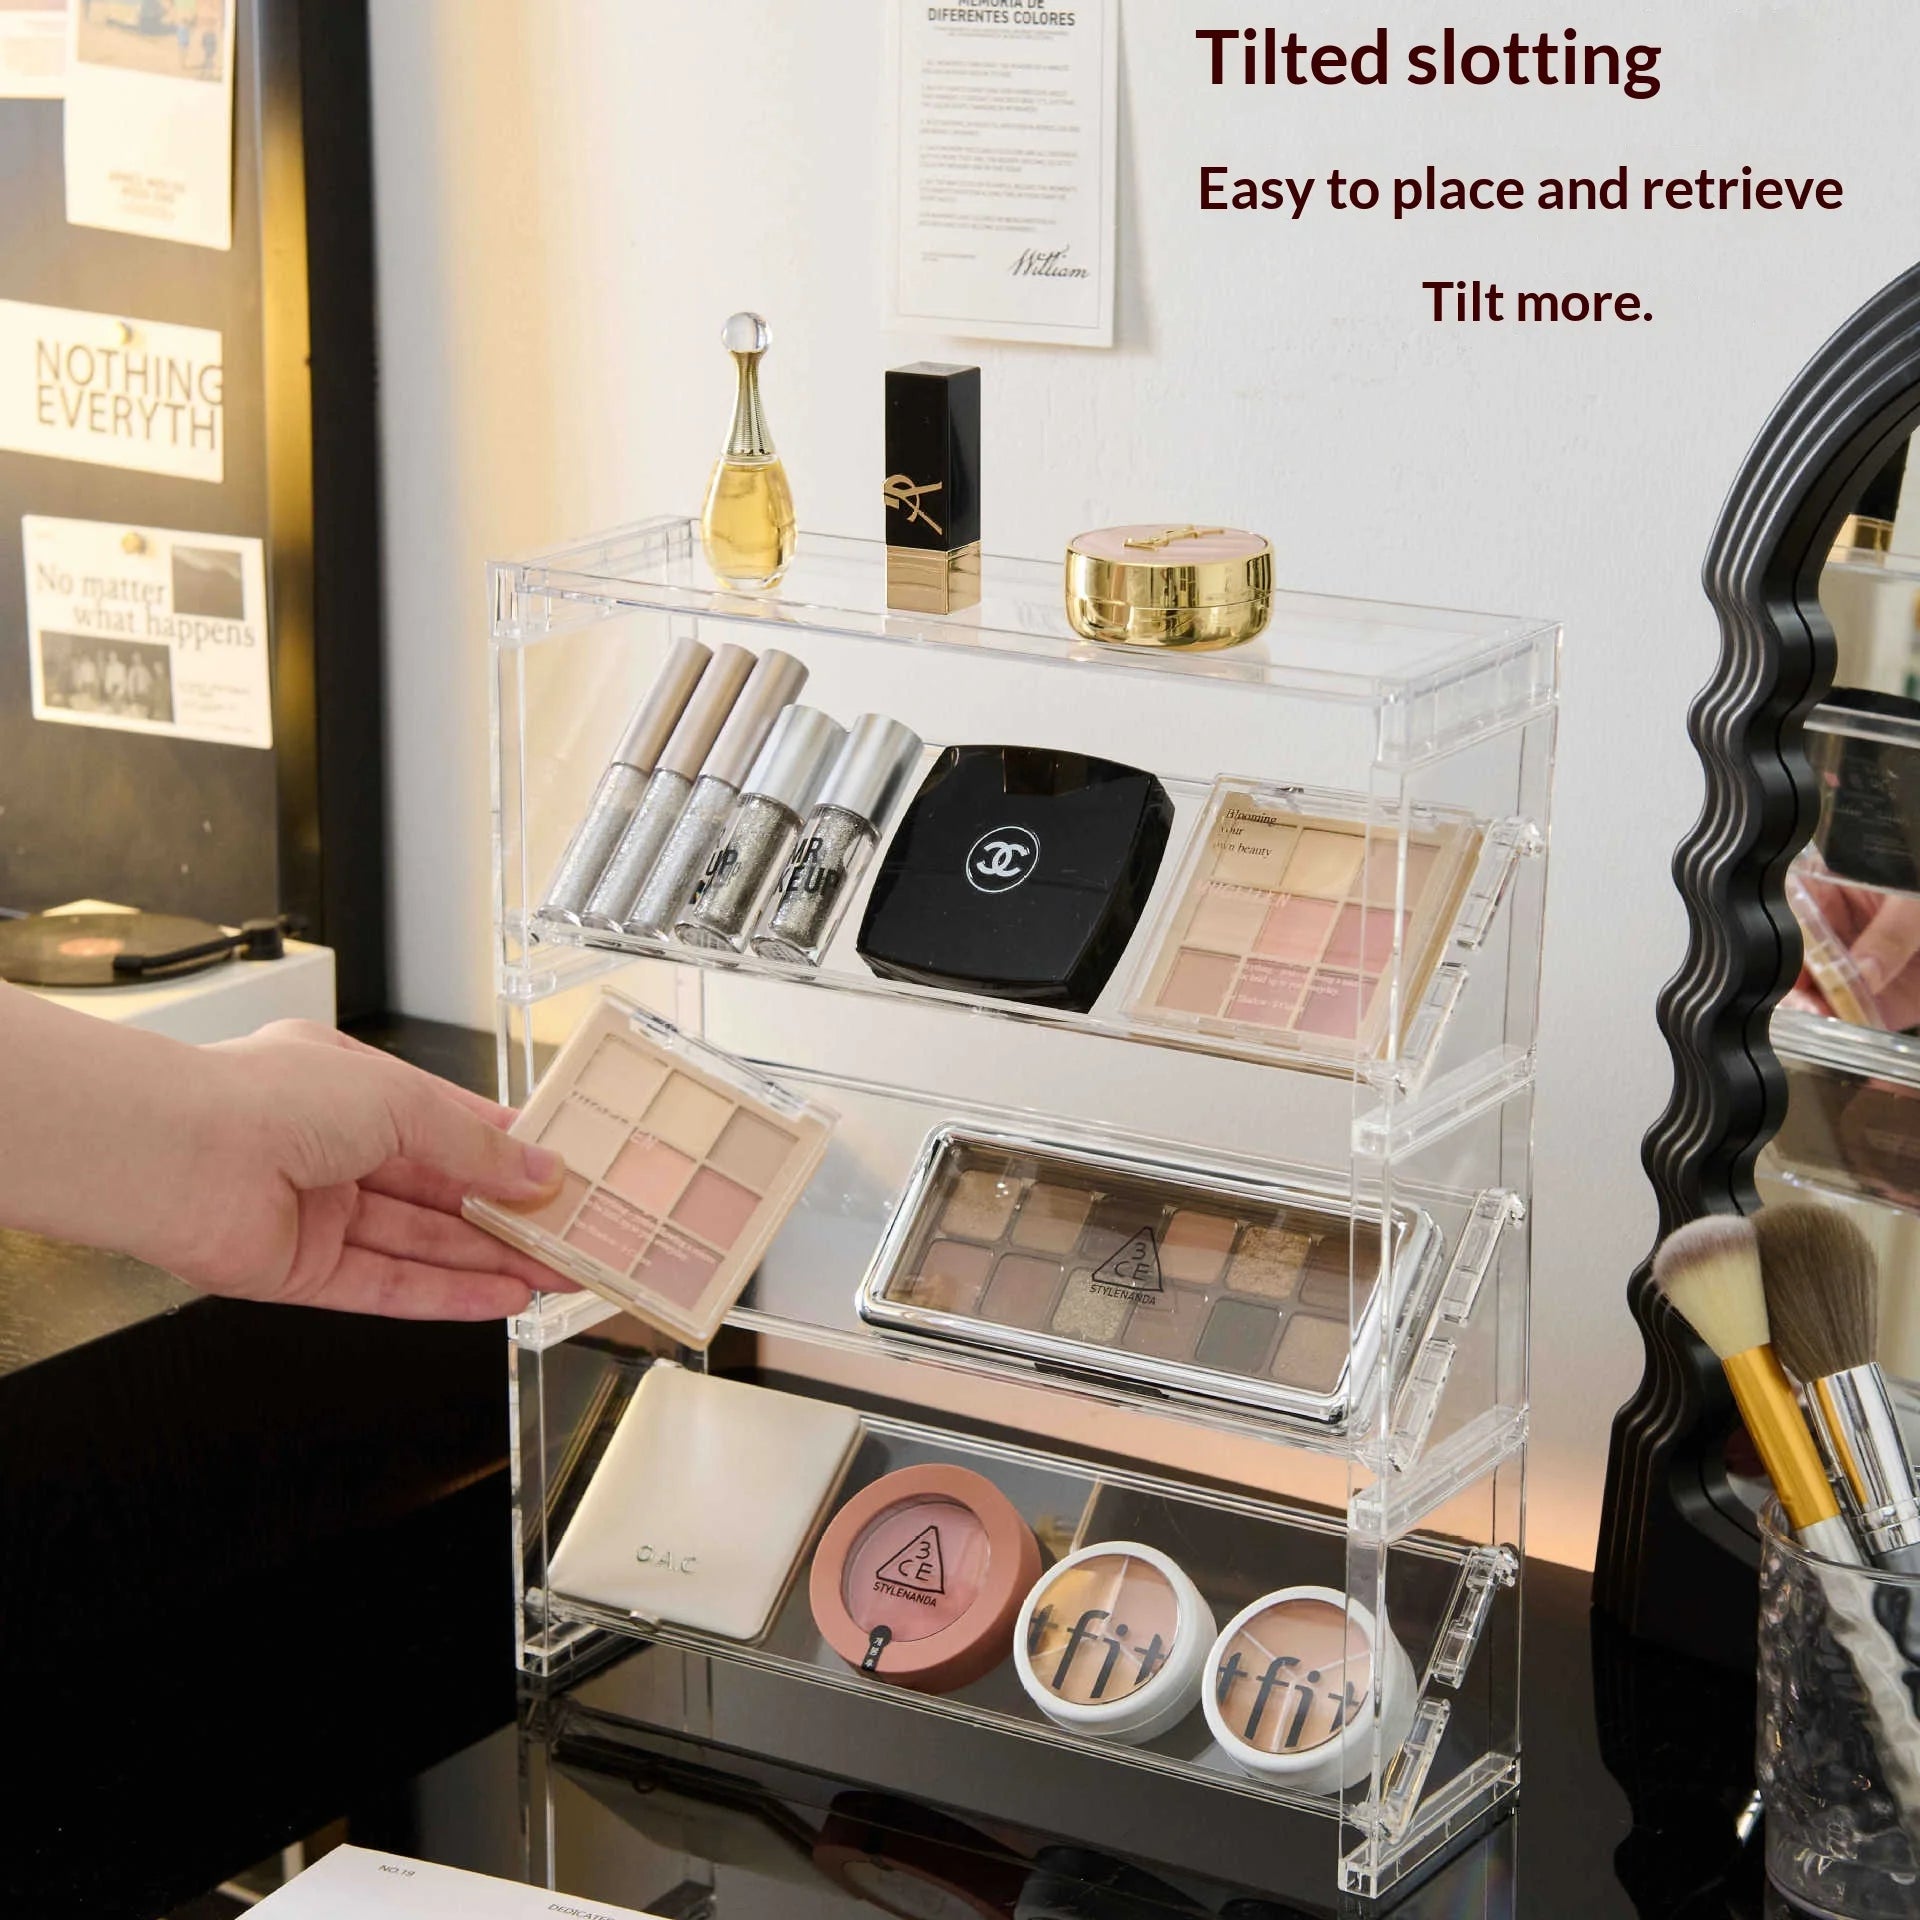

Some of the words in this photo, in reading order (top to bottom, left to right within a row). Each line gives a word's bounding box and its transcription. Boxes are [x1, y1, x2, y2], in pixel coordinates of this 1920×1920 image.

[928, 8, 1009, 24] DIFERENTES
[1013, 11, 1076, 26] COLORES
[36, 339, 223, 407] NOTHING
[37, 383, 216, 451] EVERYTH
[37, 561, 73, 595] No
[82, 575, 165, 606] matter
[74, 604, 135, 634] what
[146, 604, 256, 652] happens
[1226, 808, 1278, 828] Blooming
[1238, 842, 1273, 859] beauty
[1131, 1242, 1147, 1260] 3
[1114, 1261, 1153, 1281] CE
[1088, 1283, 1157, 1305] STYLENANDA
[915, 1540, 932, 1560] 3
[898, 1559, 934, 1582] CE
[872, 1581, 938, 1608] STYLENANDA
